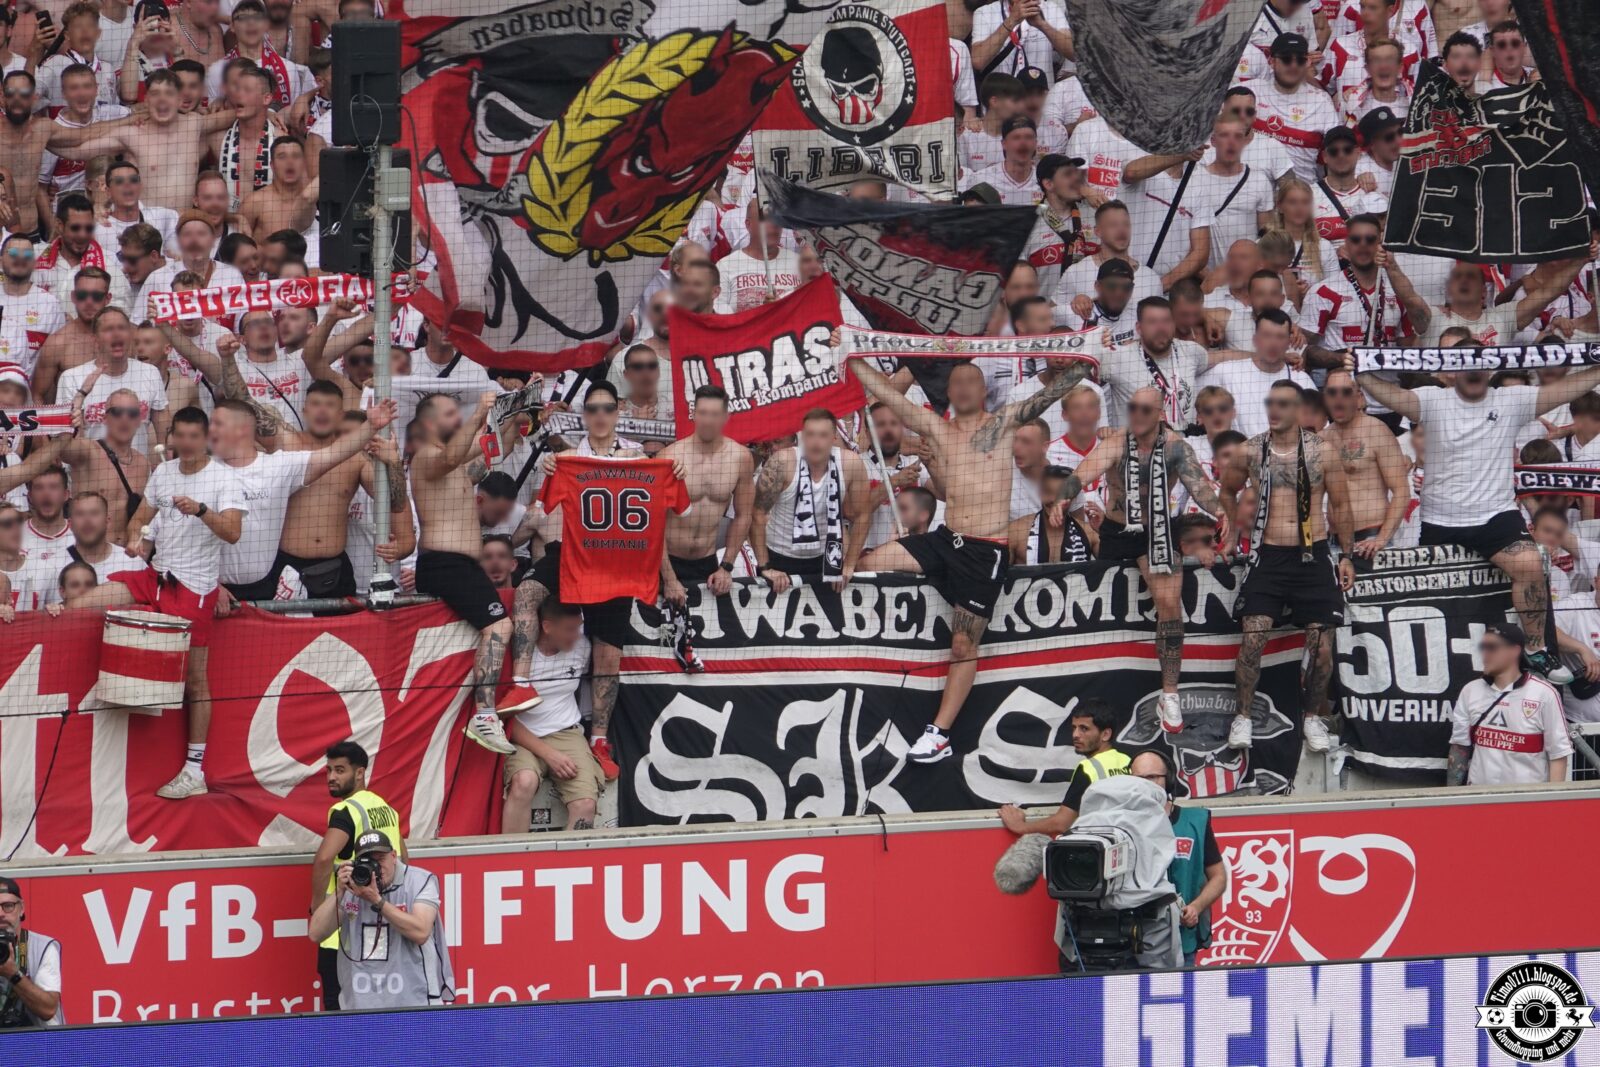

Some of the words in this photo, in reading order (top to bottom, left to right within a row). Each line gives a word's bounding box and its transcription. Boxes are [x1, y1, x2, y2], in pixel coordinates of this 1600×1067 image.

[155, 283, 270, 322] BETZE
[1354, 343, 1587, 373] KESSELSTADT
[750, 371, 839, 407] Kompanie
[576, 466, 657, 486] SCHWABEN
[580, 486, 652, 532] 06
[582, 538, 649, 550] KOMPANIE
[1372, 547, 1430, 570] EHRE
[1346, 569, 1470, 597] VERSTORBENEN
[1179, 691, 1238, 713] chwaben
